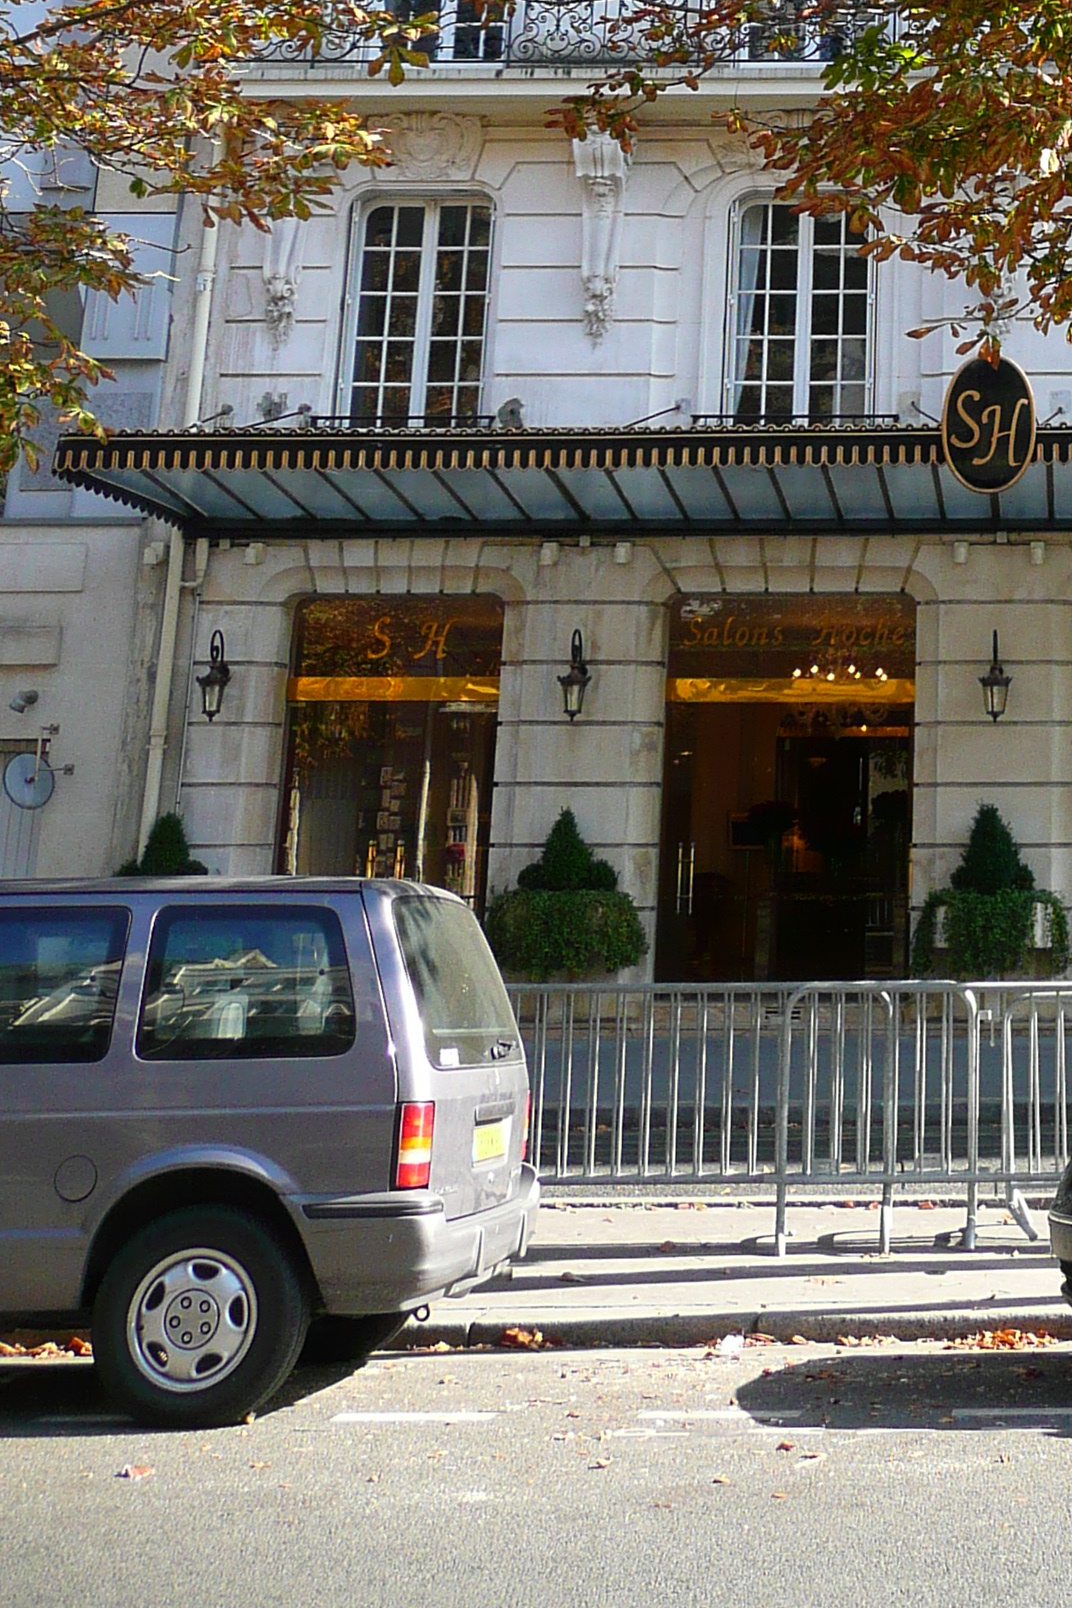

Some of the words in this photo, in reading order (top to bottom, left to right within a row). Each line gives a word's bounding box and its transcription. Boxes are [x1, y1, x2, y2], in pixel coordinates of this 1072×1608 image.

[949, 389, 1029, 467] SH
[366, 615, 391, 659] S
[412, 617, 458, 659] H
[683, 616, 784, 647] Salons
